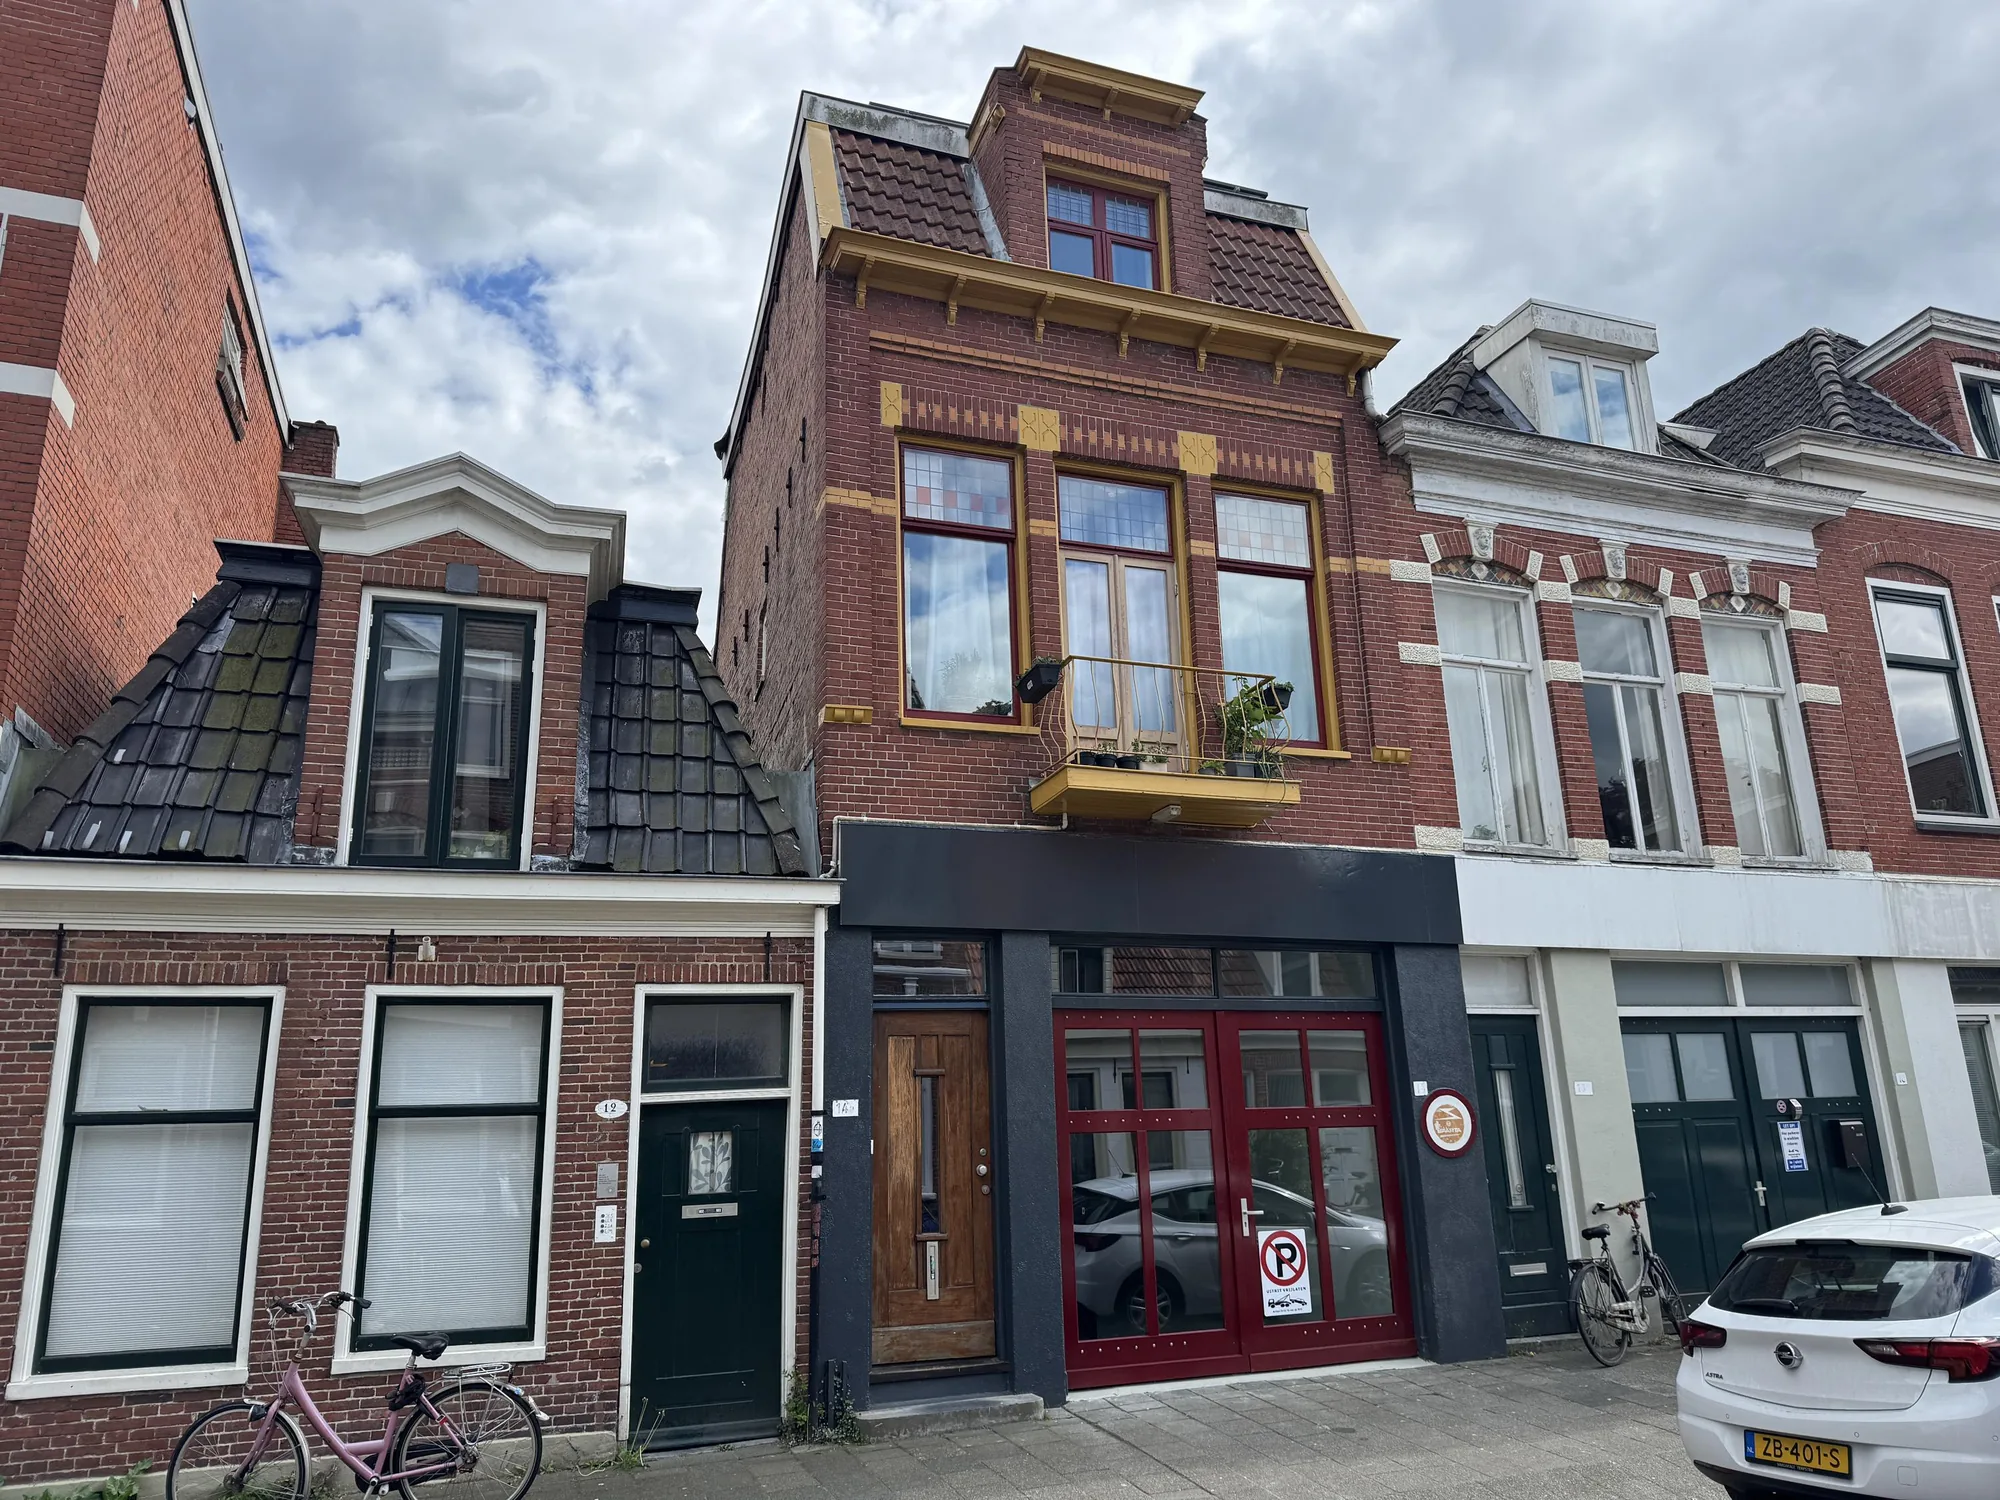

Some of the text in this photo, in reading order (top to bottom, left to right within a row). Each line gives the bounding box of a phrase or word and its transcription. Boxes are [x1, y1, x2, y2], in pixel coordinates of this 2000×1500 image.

[604, 1102, 617, 1113] 12
[1275, 1243, 1297, 1277] P
[1705, 1371, 1724, 1380] ASTRA
[1746, 1446, 1754, 1454] NL
[1762, 1436, 1840, 1469] ZB-401-S
